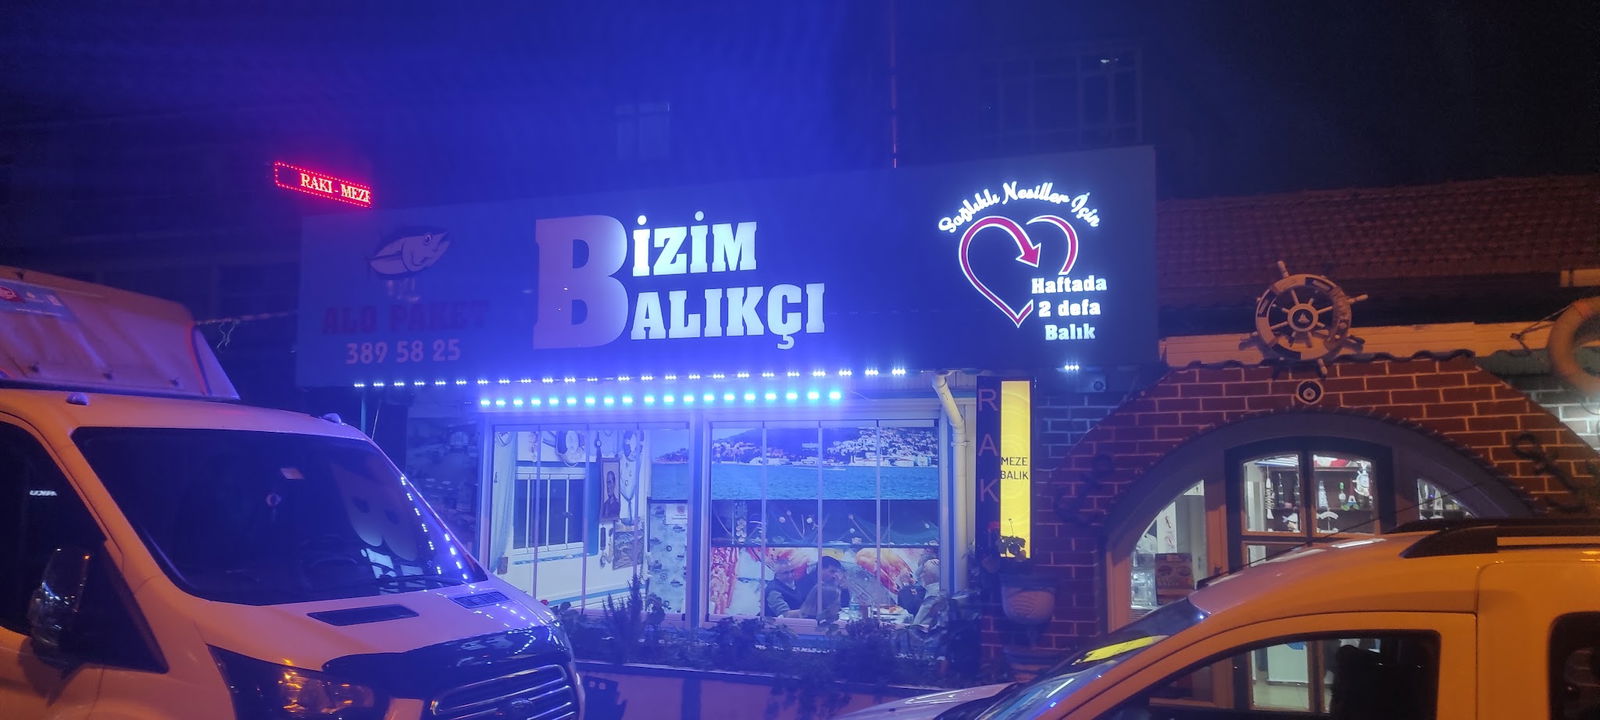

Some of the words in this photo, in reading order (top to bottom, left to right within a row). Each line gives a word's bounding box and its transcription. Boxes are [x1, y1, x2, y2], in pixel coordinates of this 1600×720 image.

[938, 188, 1001, 234] Sağlıklı
[1001, 180, 1070, 205] Nesiller
[1031, 274, 1108, 295] Haftada
[1038, 300, 1052, 318] 2
[1057, 299, 1102, 317] defa
[322, 308, 376, 334] ALO
[1044, 323, 1096, 341] Balık
[345, 342, 388, 365] 389
[396, 341, 424, 364] 58
[432, 339, 461, 361] 25
[1000, 456, 1029, 467] MEZE
